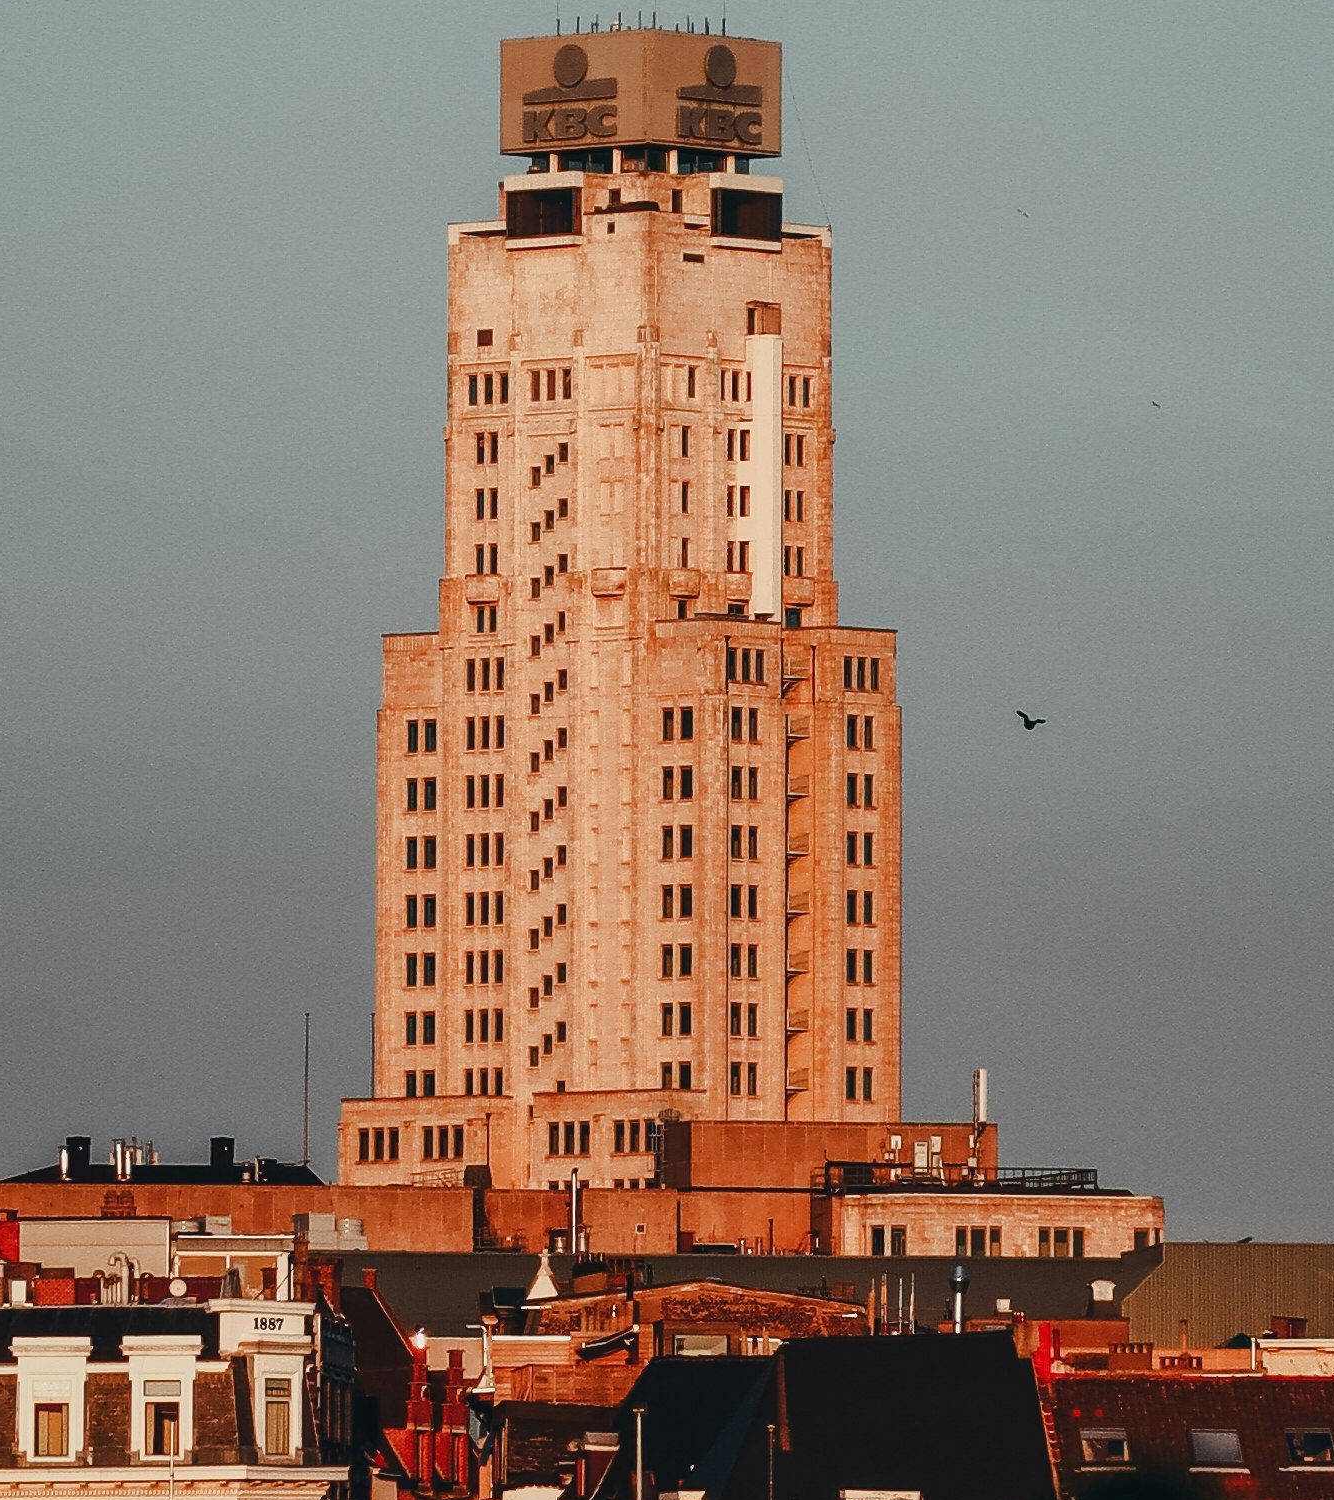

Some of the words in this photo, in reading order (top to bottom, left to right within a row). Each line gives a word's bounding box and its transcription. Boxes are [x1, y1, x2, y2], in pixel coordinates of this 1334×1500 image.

[522, 104, 618, 143] KBC
[677, 105, 763, 145] KBC
[253, 1317, 284, 1331] 1887
